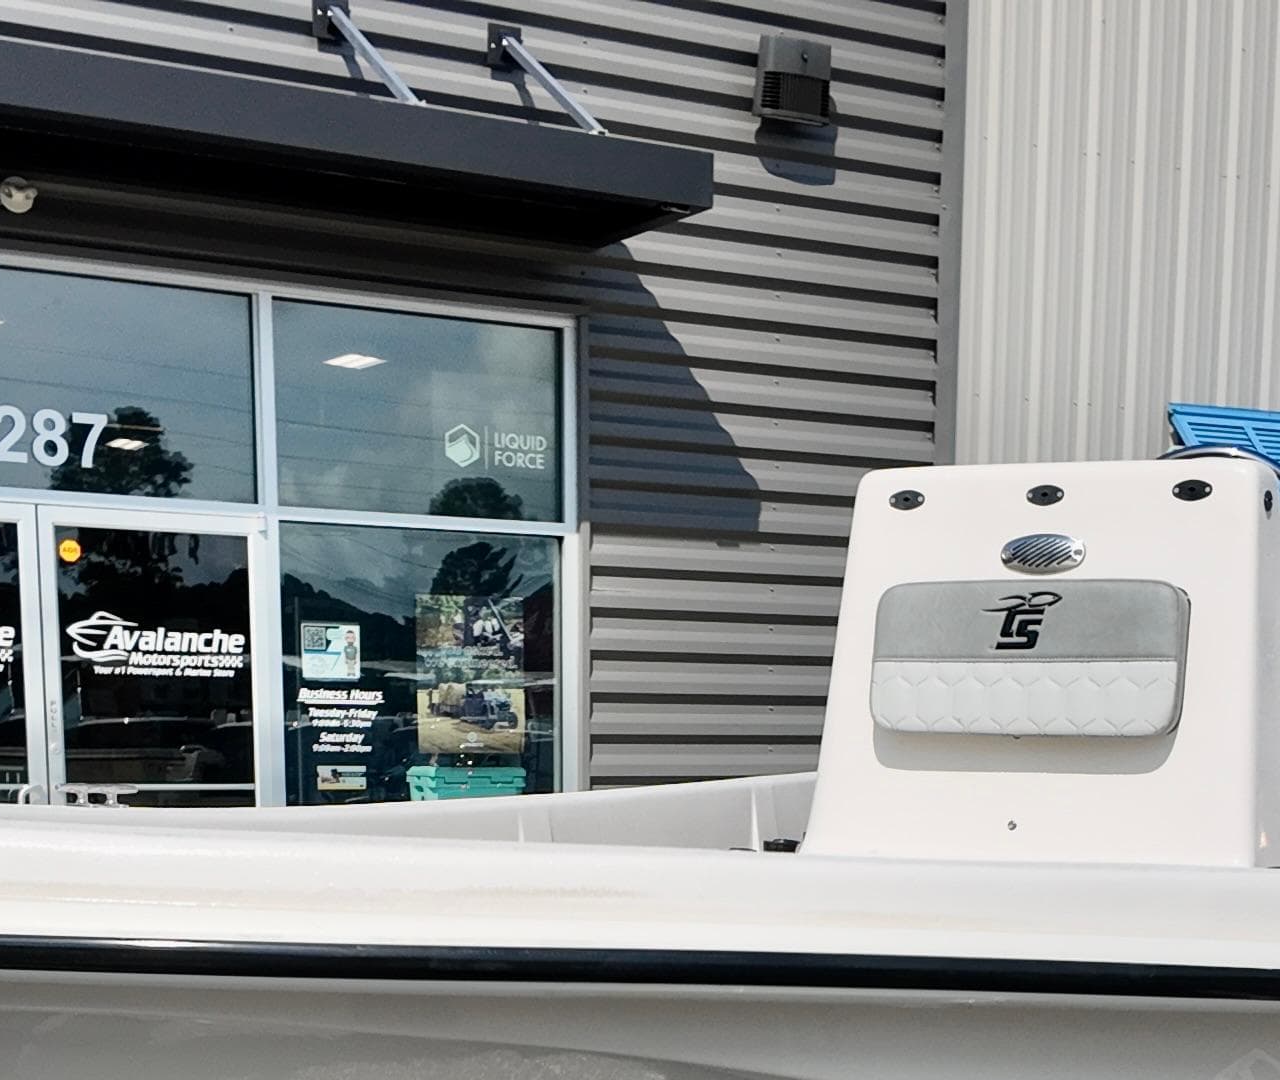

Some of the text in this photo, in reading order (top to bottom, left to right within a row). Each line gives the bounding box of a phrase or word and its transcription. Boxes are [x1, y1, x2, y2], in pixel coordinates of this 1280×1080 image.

[494, 432, 547, 451] LIQUID
[494, 450, 545, 469] FORCE
[103, 625, 246, 654] Avalanche
[128, 651, 220, 670] Motorsports
[298, 687, 384, 701] Business Hours
[319, 732, 365, 745] Saturday
